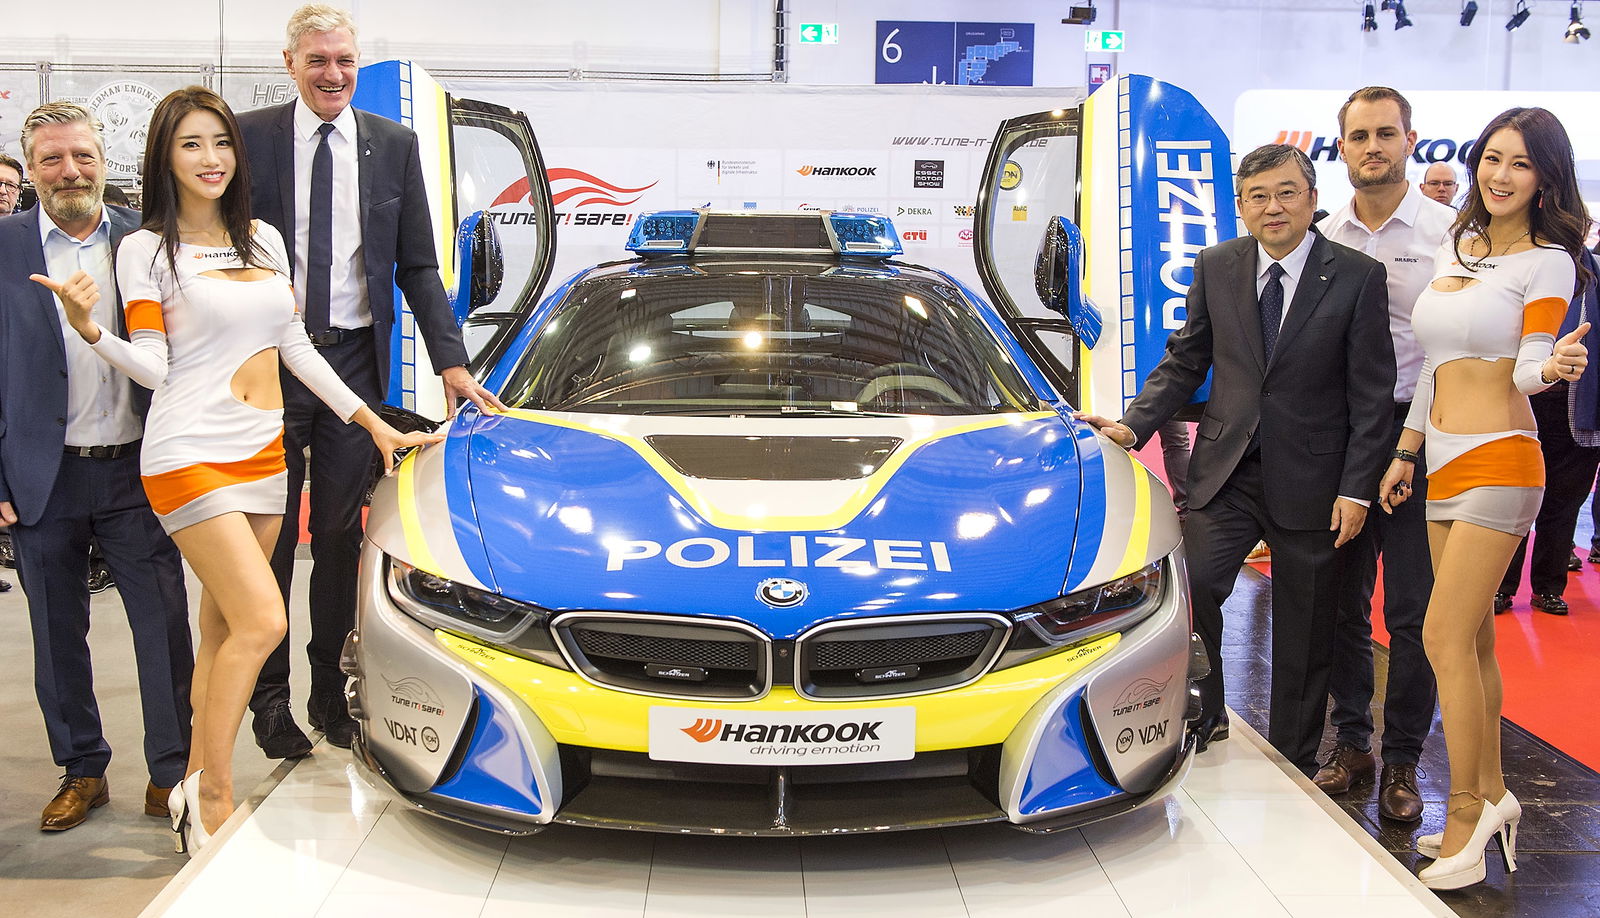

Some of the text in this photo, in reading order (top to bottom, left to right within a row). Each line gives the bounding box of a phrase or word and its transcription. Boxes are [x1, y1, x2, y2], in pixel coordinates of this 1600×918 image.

[882, 28, 902, 63] 6
[106, 157, 137, 173] OTORS
[907, 207, 932, 215] DEKRA
[903, 229, 927, 241] GTÜ
[606, 535, 952, 573] POLIZEI
[750, 743, 881, 757] driving emotion
